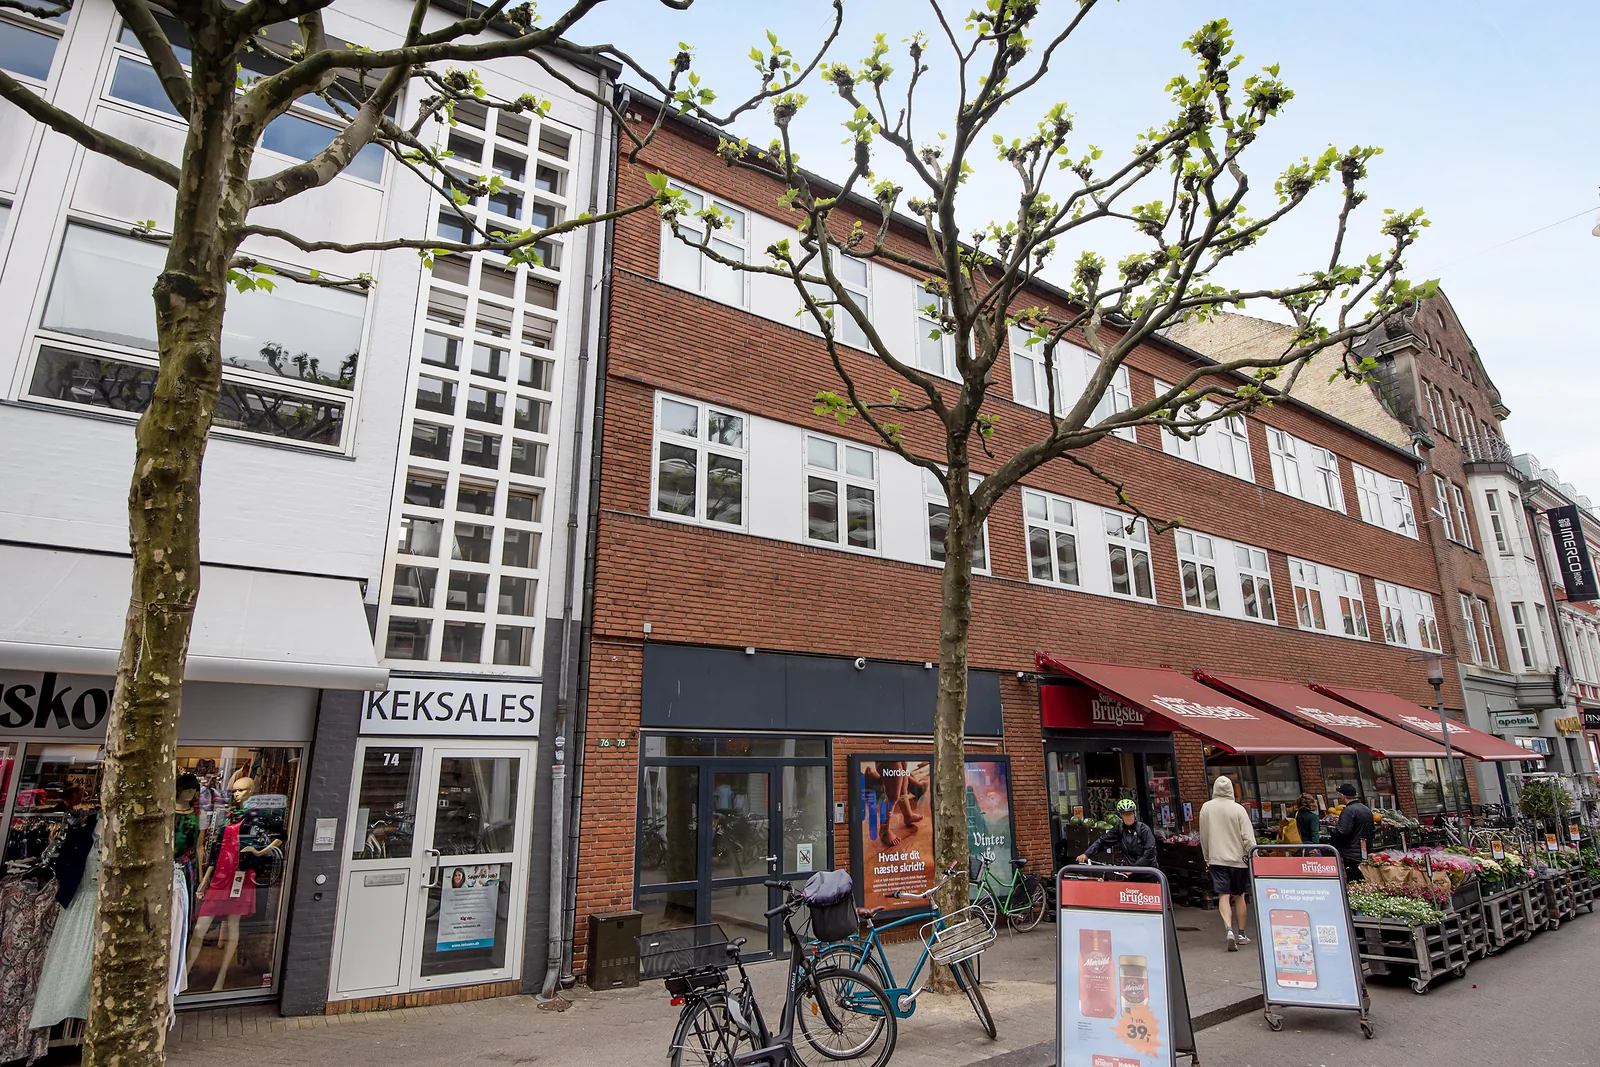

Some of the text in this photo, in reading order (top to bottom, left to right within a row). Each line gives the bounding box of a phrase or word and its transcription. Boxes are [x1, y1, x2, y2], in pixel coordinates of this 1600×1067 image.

[1560, 527, 1582, 572] IMERCO
[0, 672, 114, 730] sko
[366, 690, 535, 723] KEKSALES
[1092, 699, 1144, 727] Brugsen
[1498, 717, 1534, 726] apotek
[384, 753, 400, 766] 74
[882, 768, 911, 777] Nordea
[972, 831, 1005, 847] Vinter
[878, 852, 899, 862] Hvad
[909, 850, 920, 861] dit
[874, 861, 926, 875] næste skridt?
[1301, 863, 1336, 873] Brugsen
[1119, 891, 1160, 905] Brugsen
